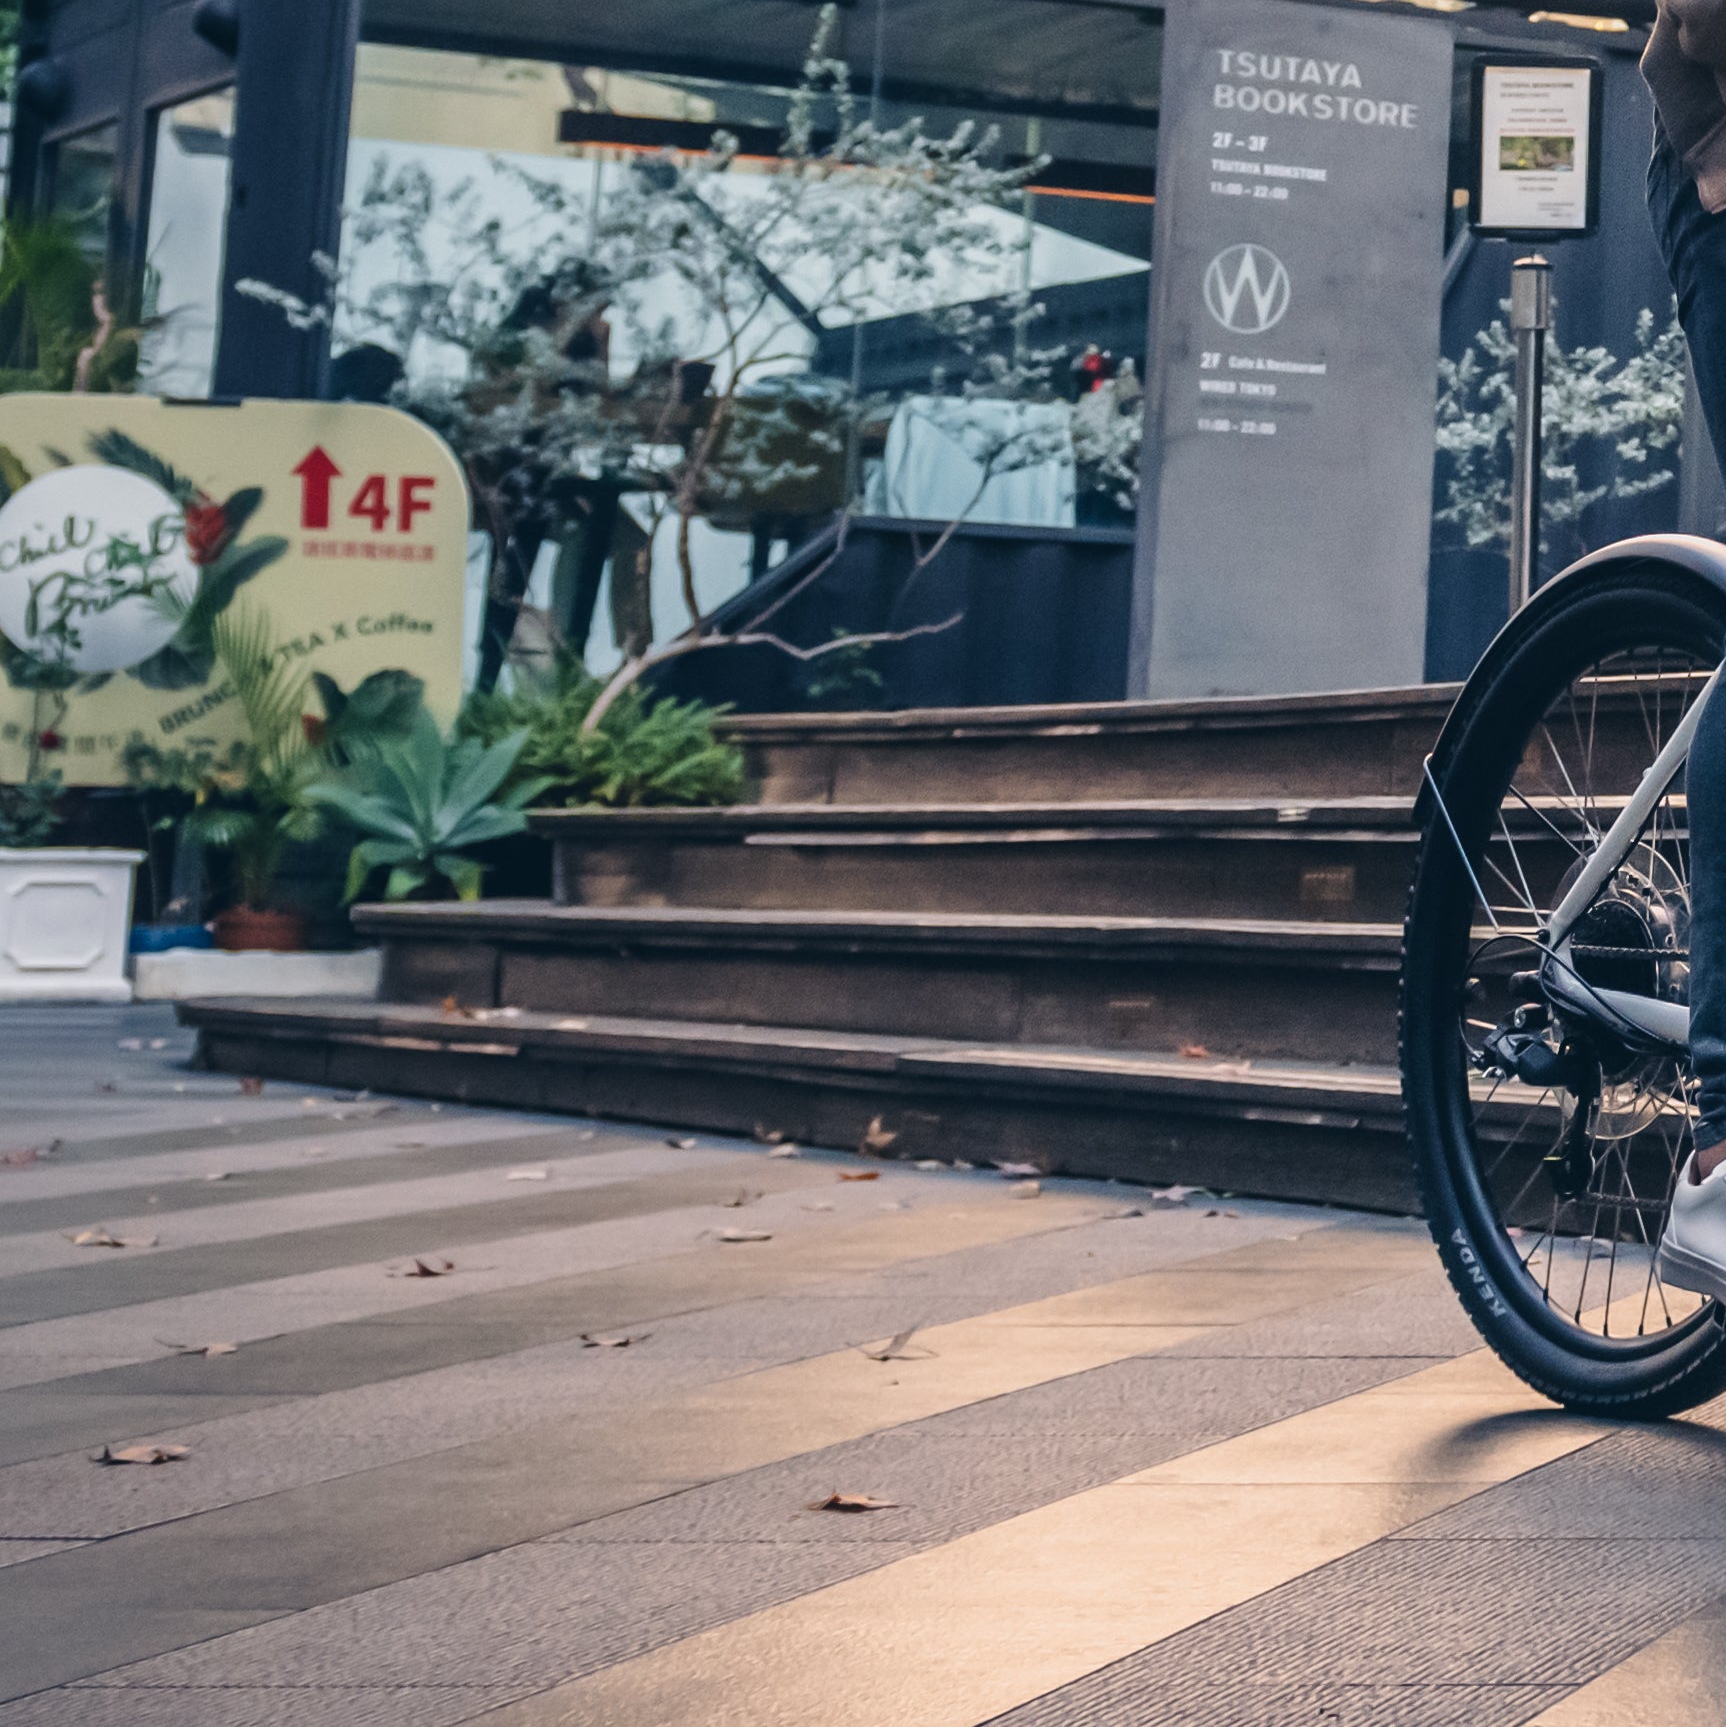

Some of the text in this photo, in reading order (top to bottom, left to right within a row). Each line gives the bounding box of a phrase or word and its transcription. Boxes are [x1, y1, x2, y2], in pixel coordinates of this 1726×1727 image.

[1217, 48, 1363, 89] TSUTAYA
[1213, 83, 1419, 128] BOOKSTORE
[349, 473, 437, 533] 4F
[356, 612, 434, 635] Coffee
[1451, 1227, 1507, 1318] KENDA
